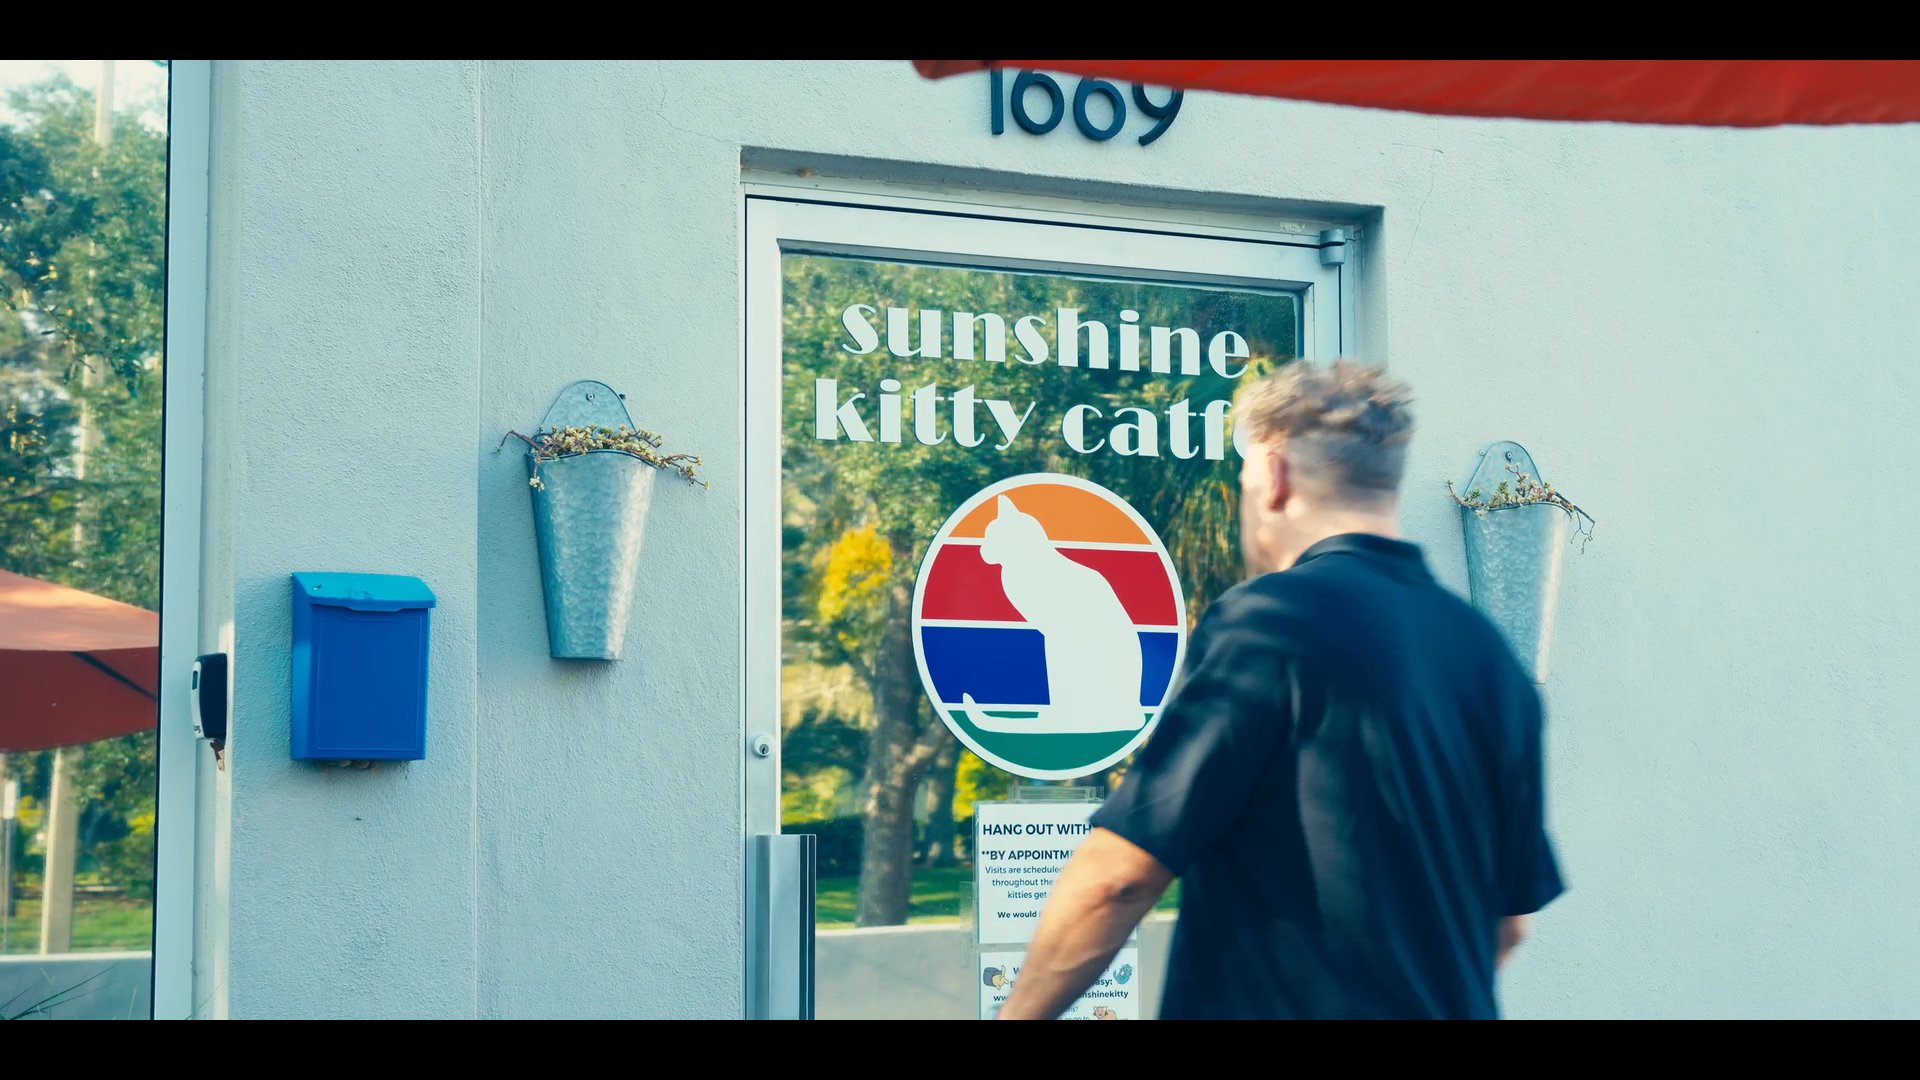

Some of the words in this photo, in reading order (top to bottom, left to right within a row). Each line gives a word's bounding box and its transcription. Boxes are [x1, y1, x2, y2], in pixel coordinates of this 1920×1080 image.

[990, 67, 1184, 147] 1669
[841, 304, 1250, 379] sunshine
[815, 378, 1037, 451] kitty
[983, 824, 1022, 835] HANG
[1025, 824, 1054, 835] OUT
[1056, 824, 1092, 835] WITH
[985, 866, 1007, 874] Visits
[992, 879, 1038, 888] throughout
[1007, 891, 1033, 899] kitties
[1034, 892, 1047, 900] get
